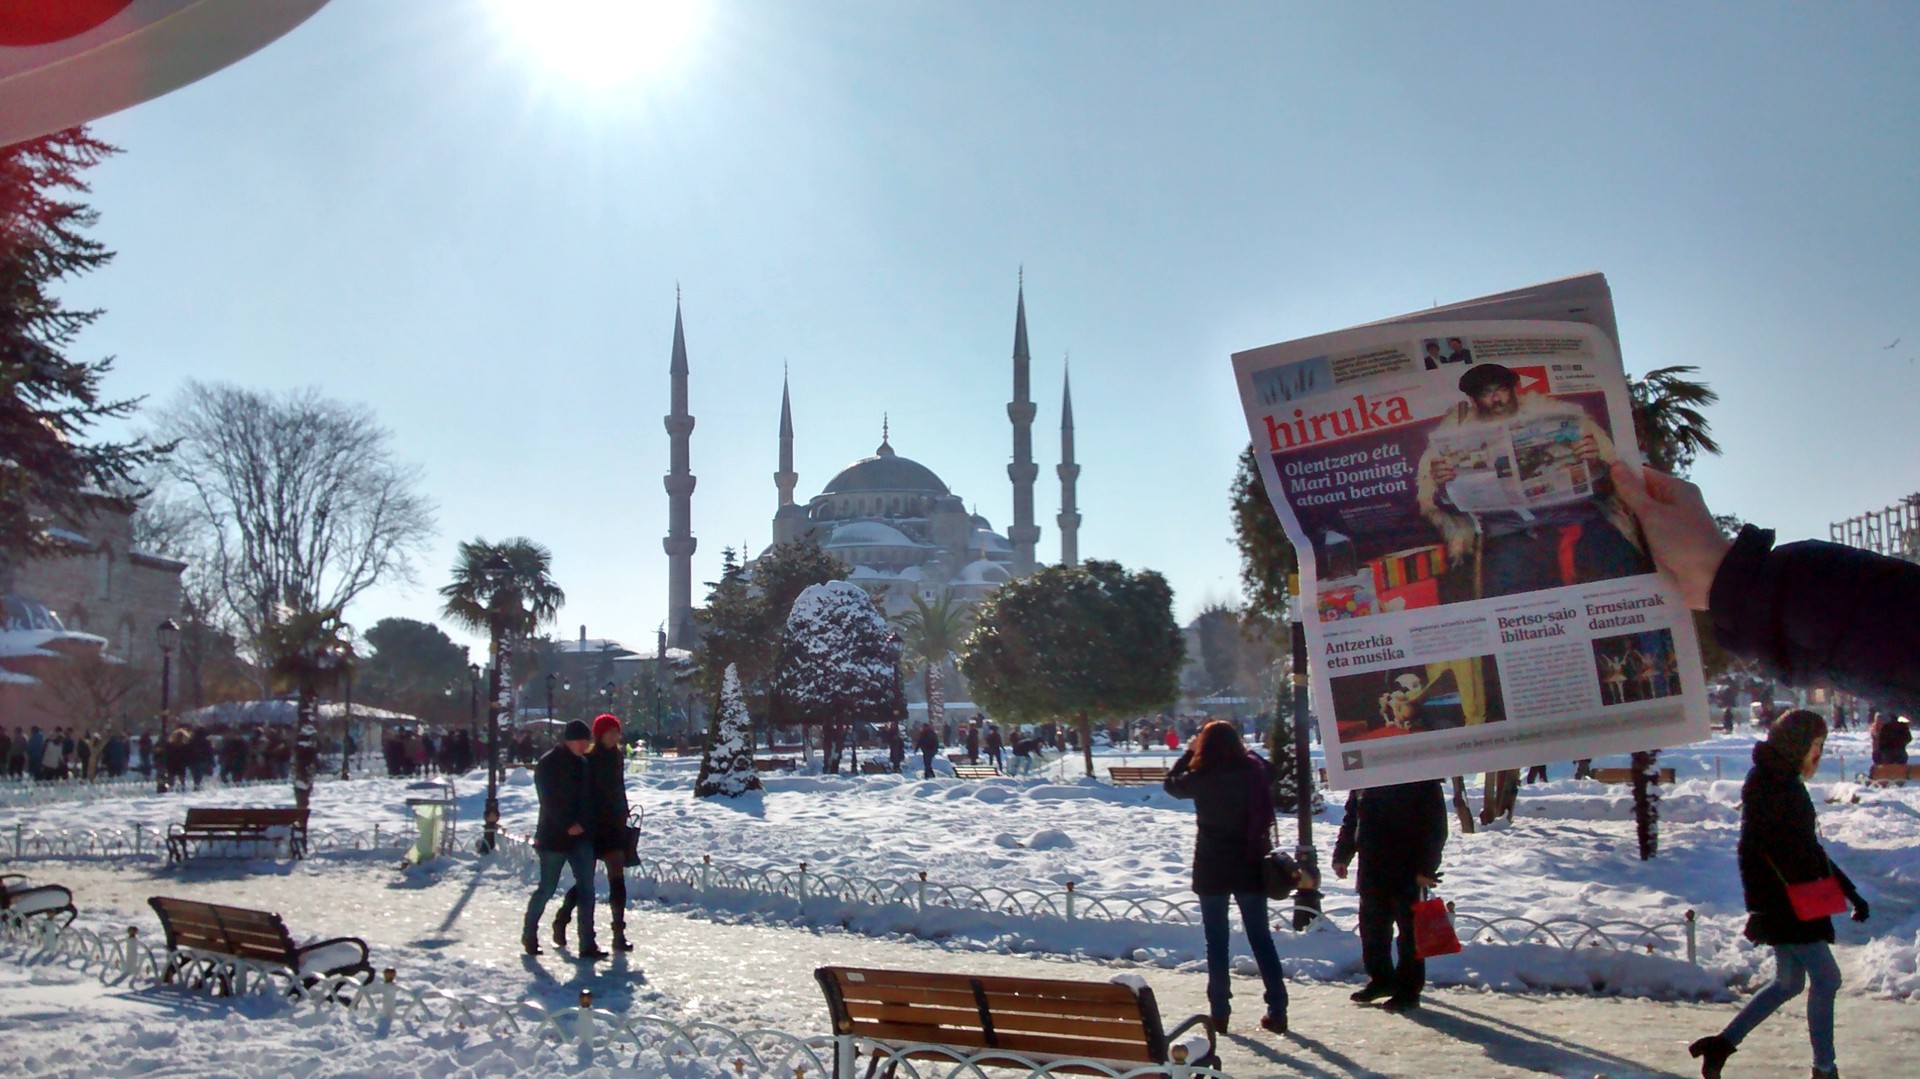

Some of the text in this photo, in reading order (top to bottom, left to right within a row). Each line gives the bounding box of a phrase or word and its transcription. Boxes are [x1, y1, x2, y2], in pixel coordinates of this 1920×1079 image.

[1263, 394, 1413, 450] hiruka
[1285, 443, 1401, 476] Olentzero eta
[1290, 457, 1414, 494] Mari Domingi,
[1296, 479, 1408, 507] atoan berton
[1585, 593, 1665, 616] Errusiarrak
[1498, 606, 1577, 629] Bertso-saio
[1588, 612, 1646, 631] dantzan
[1325, 633, 1394, 655] Antzerkia
[1501, 623, 1566, 644] ibiltariak
[1327, 648, 1405, 669] eta musika
